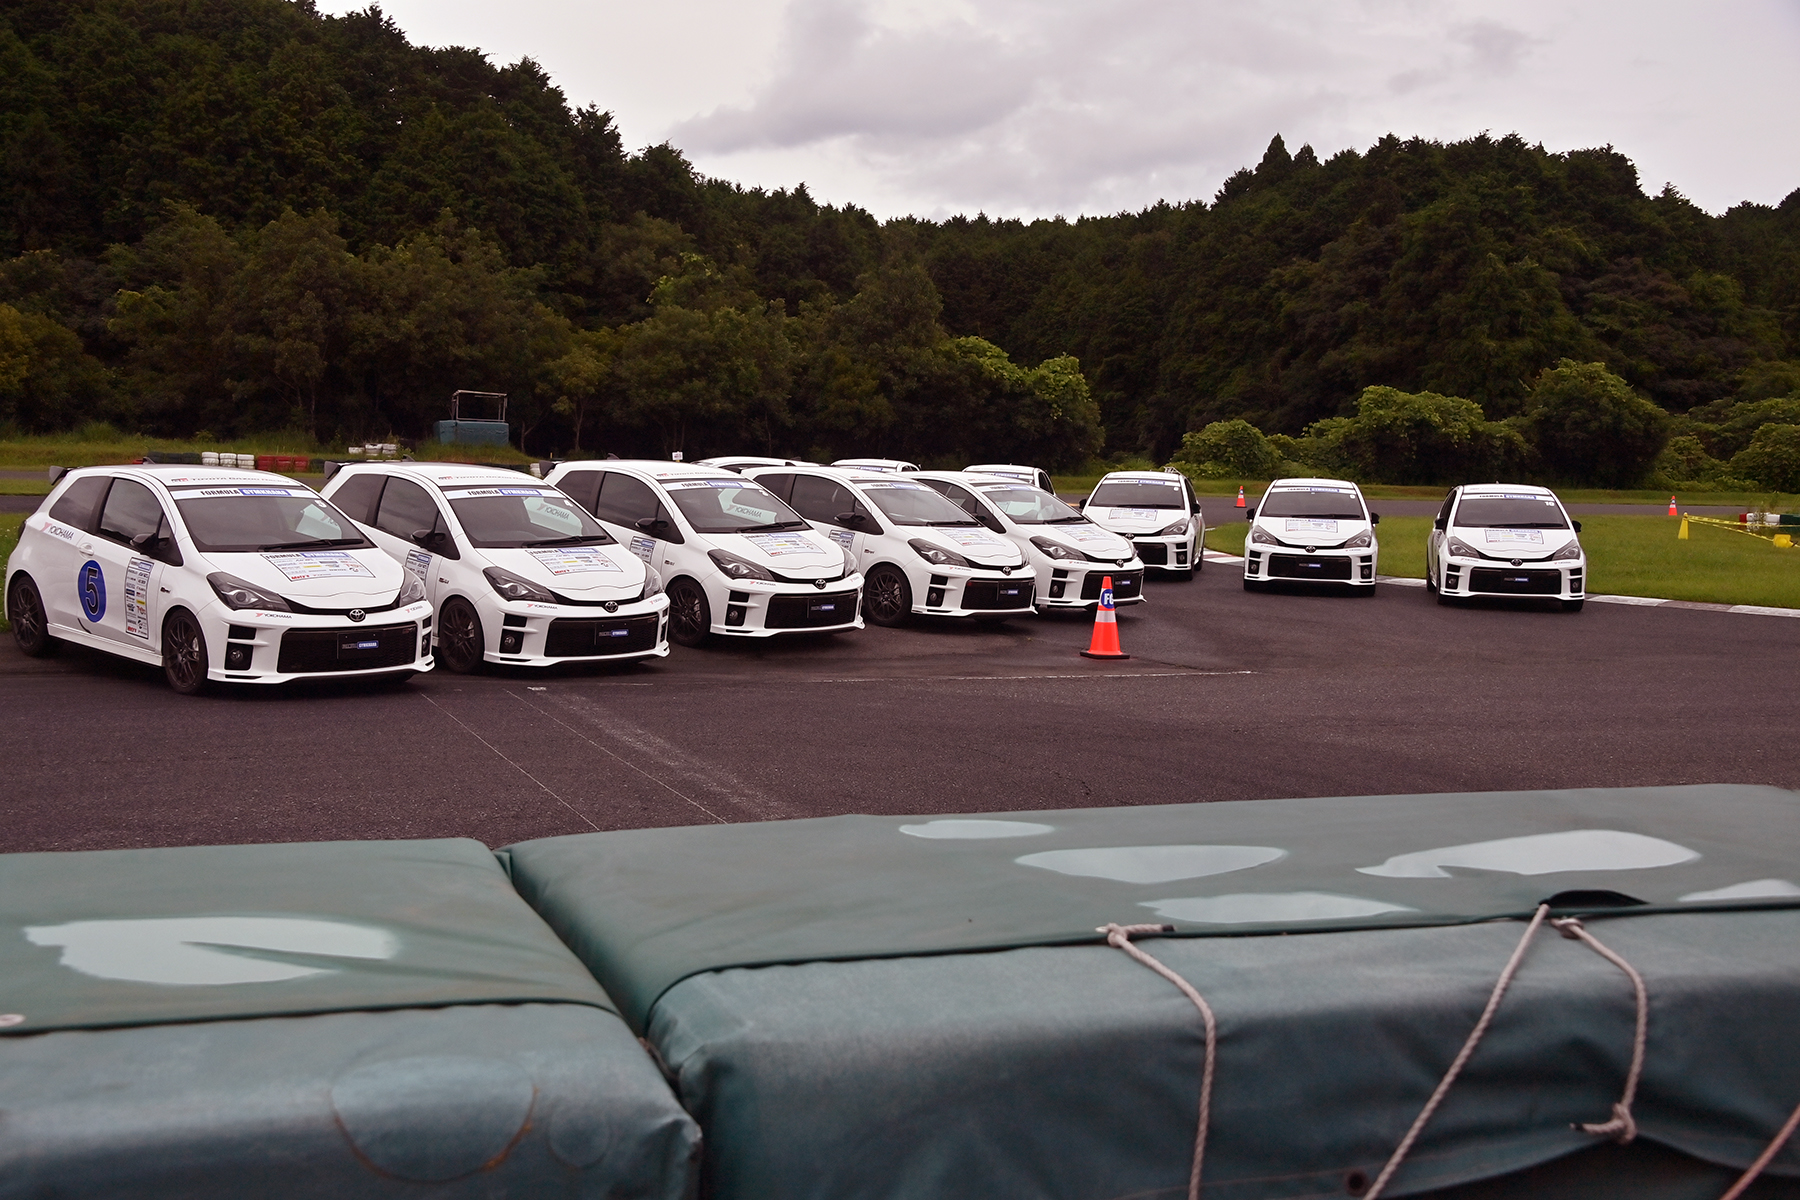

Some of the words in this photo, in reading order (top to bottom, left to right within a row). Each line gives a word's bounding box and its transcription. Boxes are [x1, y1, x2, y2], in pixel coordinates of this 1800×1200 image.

[544, 506, 570, 520] YOKOHAMA
[734, 505, 763, 518] YOKOHAMA
[49, 525, 75, 541] YOKOHAMA
[85, 566, 99, 615] 5
